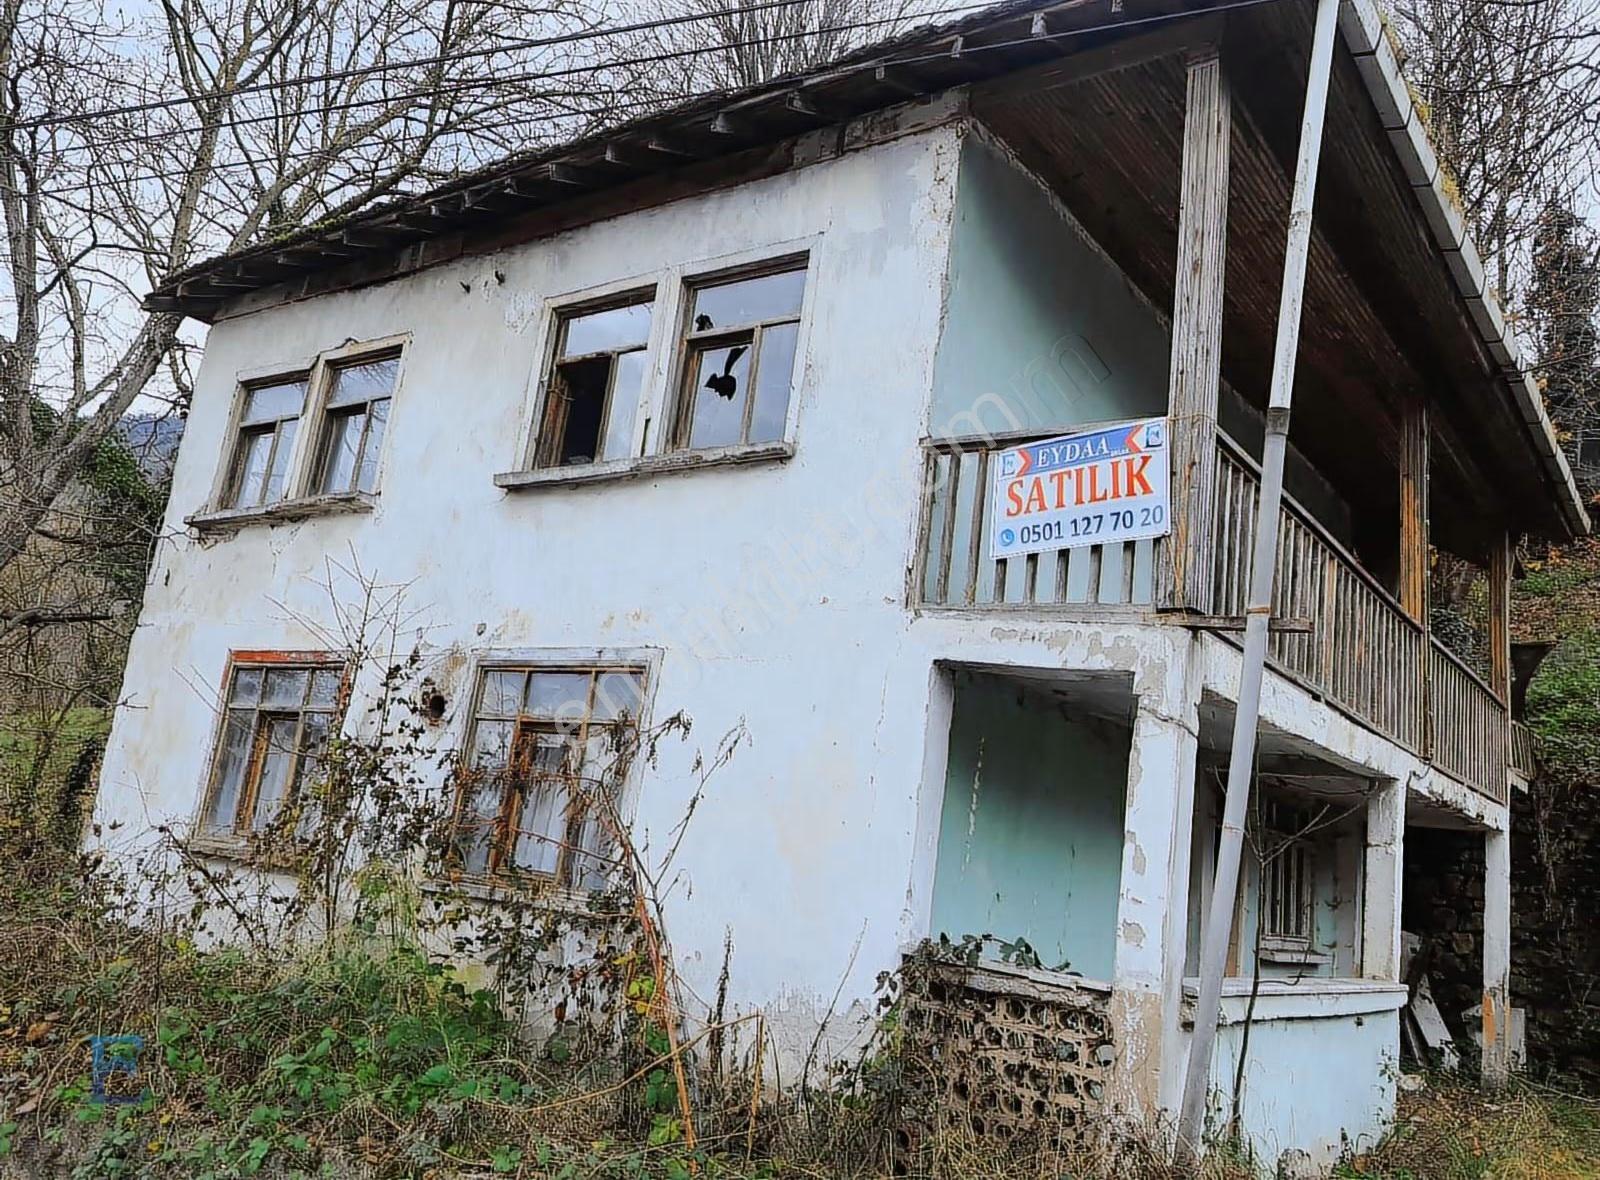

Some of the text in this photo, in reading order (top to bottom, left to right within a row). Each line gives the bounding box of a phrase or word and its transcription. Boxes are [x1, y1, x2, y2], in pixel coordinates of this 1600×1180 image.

[1037, 436, 1110, 467] EYDAA
[1006, 455, 1154, 517] SATILIK
[1020, 505, 1164, 544] 0501 127 70 20
